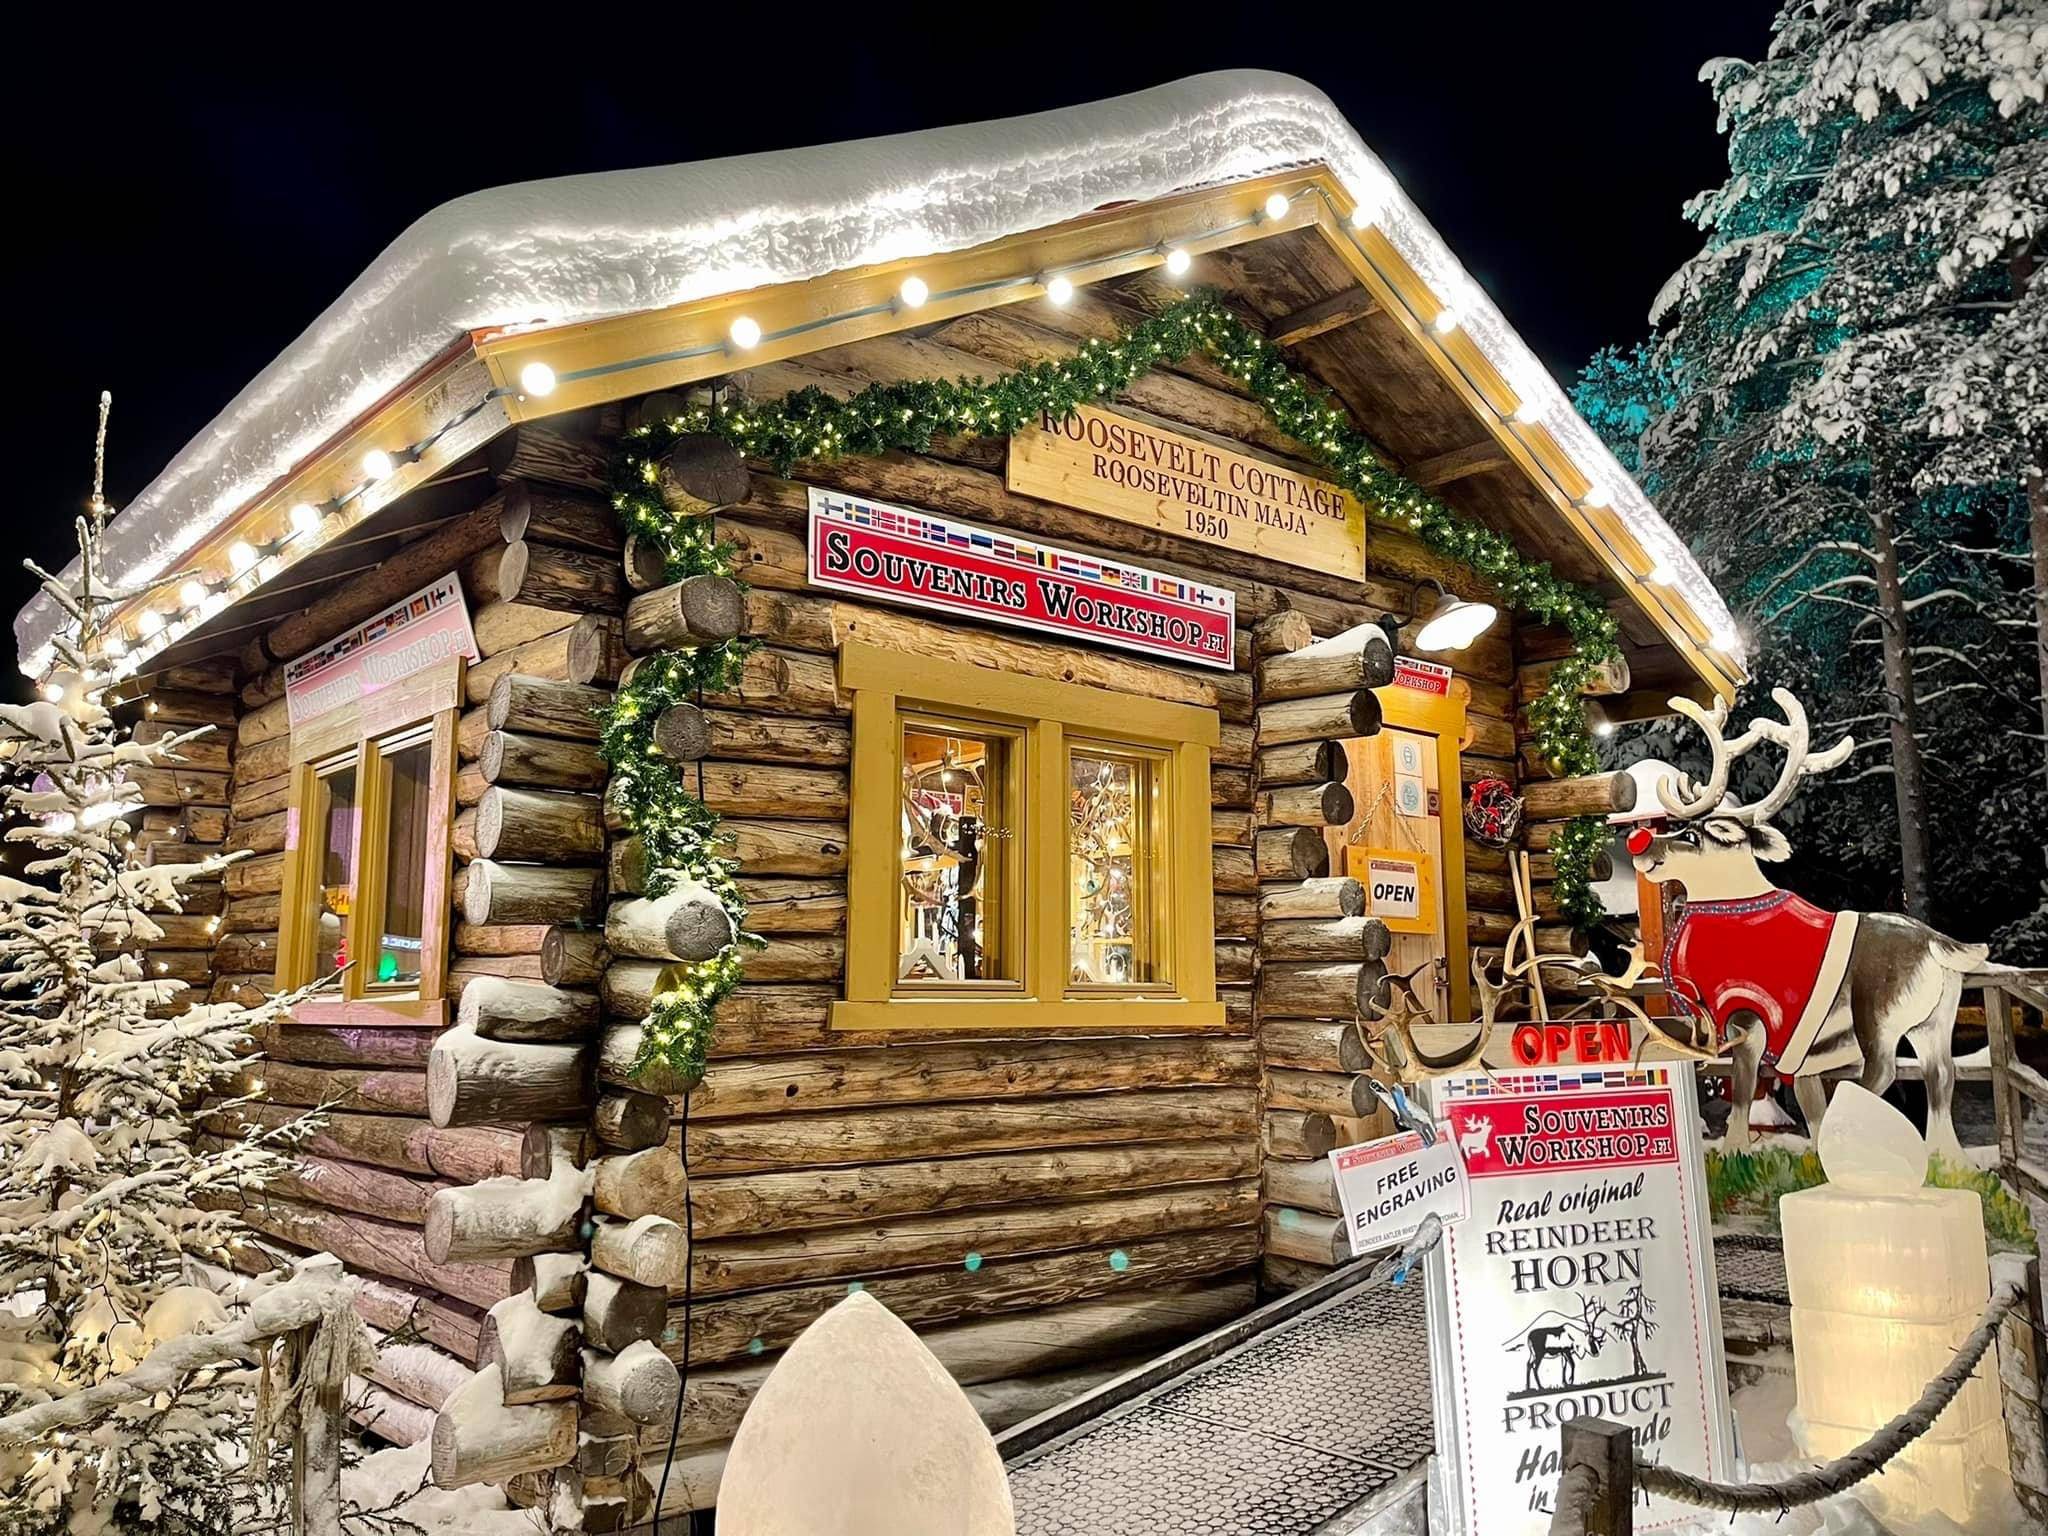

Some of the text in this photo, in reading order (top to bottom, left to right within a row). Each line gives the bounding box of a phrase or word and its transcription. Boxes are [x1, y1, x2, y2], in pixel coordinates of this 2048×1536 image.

[1040, 408, 1346, 521] ROOSEVELT COTTAGE
[1092, 454, 1308, 536] ROOSEVELTIN MAJA
[1184, 509, 1229, 540] 1950
[826, 531, 1027, 609] SOUVENIRS
[1373, 882, 1416, 903] OPEN
[1511, 1023, 1632, 1066] OPEN
[1523, 1104, 1668, 1135] SOUVENIRS
[1355, 1166, 1456, 1230] ENGRAVING
[1376, 1161, 1420, 1195] FREE
[1497, 1172, 1645, 1226] Real original
[1485, 1217, 1658, 1255] REINDEER
[1511, 1247, 1643, 1294] HORN
[1501, 1382, 1675, 1433] PRODUCT
